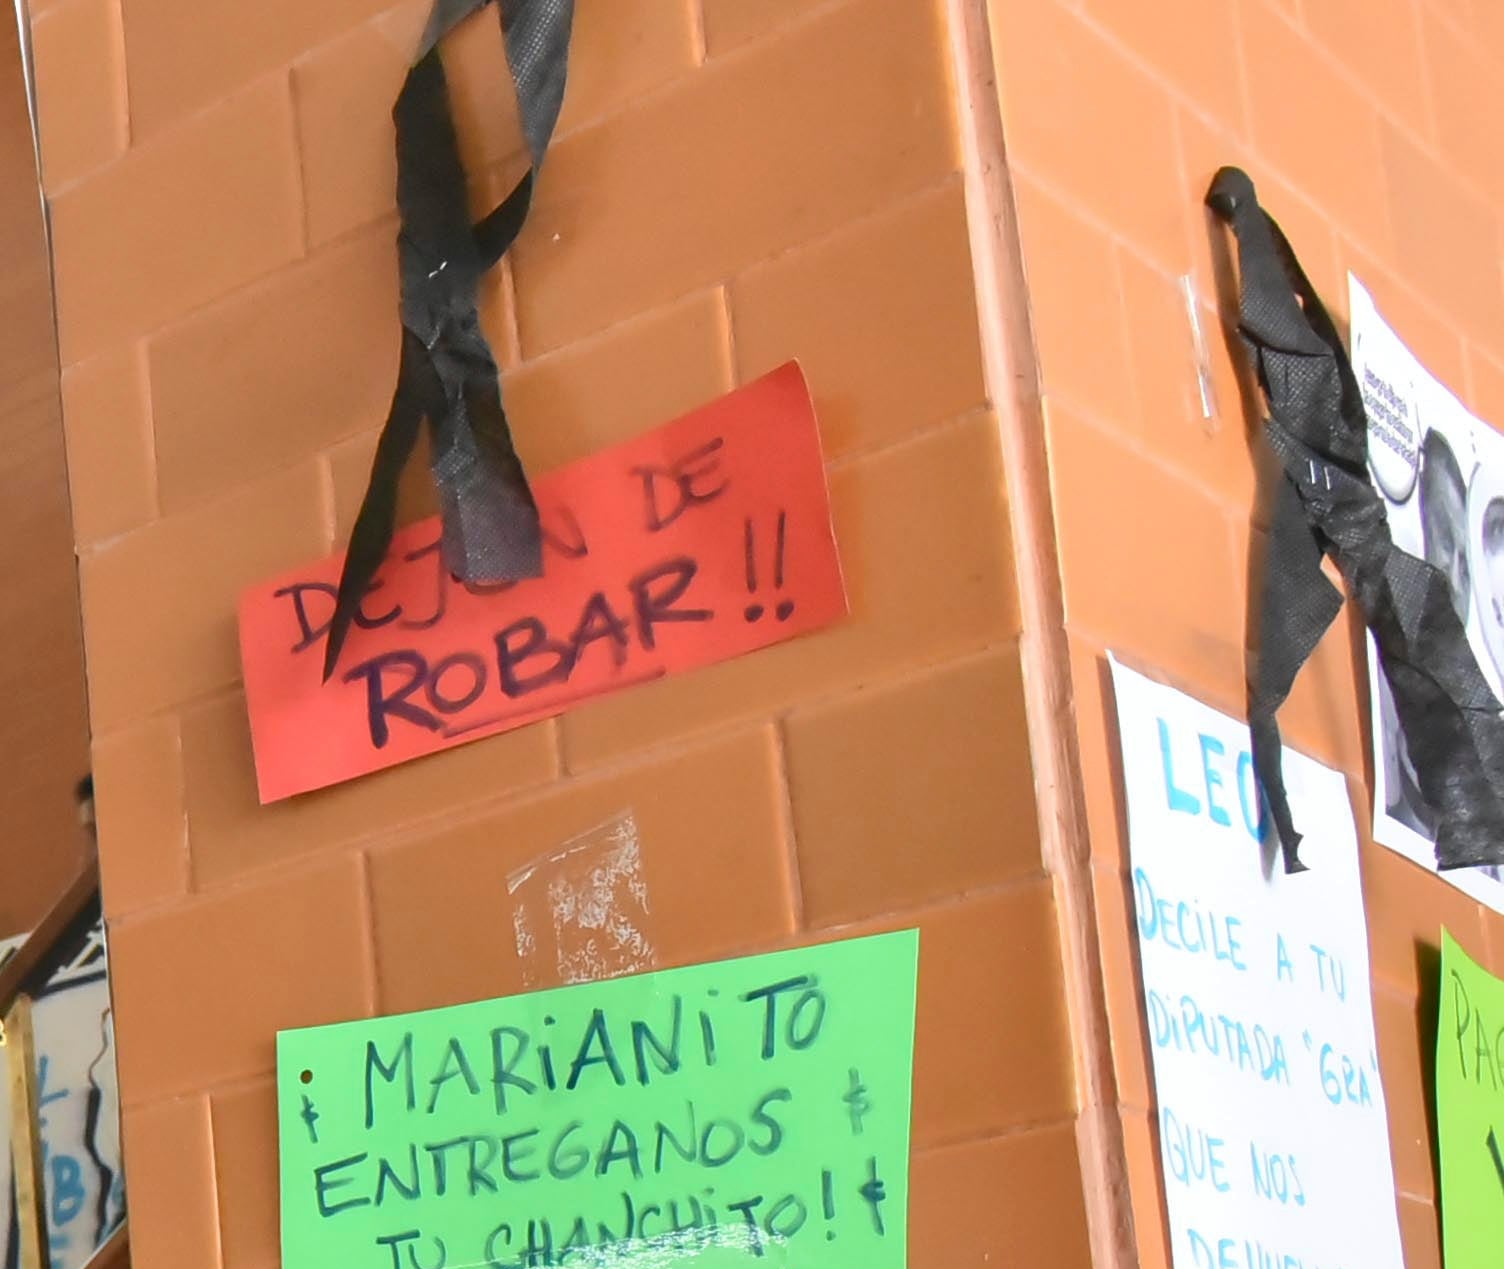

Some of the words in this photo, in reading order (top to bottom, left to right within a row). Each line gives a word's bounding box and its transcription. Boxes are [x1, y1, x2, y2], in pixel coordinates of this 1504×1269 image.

[274, 502, 588, 654] DEJN
[629, 436, 730, 533] DE
[1157, 716, 1269, 844] LEO
[1276, 932, 1294, 982] A
[1310, 944, 1346, 1002] TU
[313, 1088, 792, 1218] ENTREGANOS
[1163, 1106, 1230, 1192] QUE
[1250, 1139, 1306, 1207] NOS
